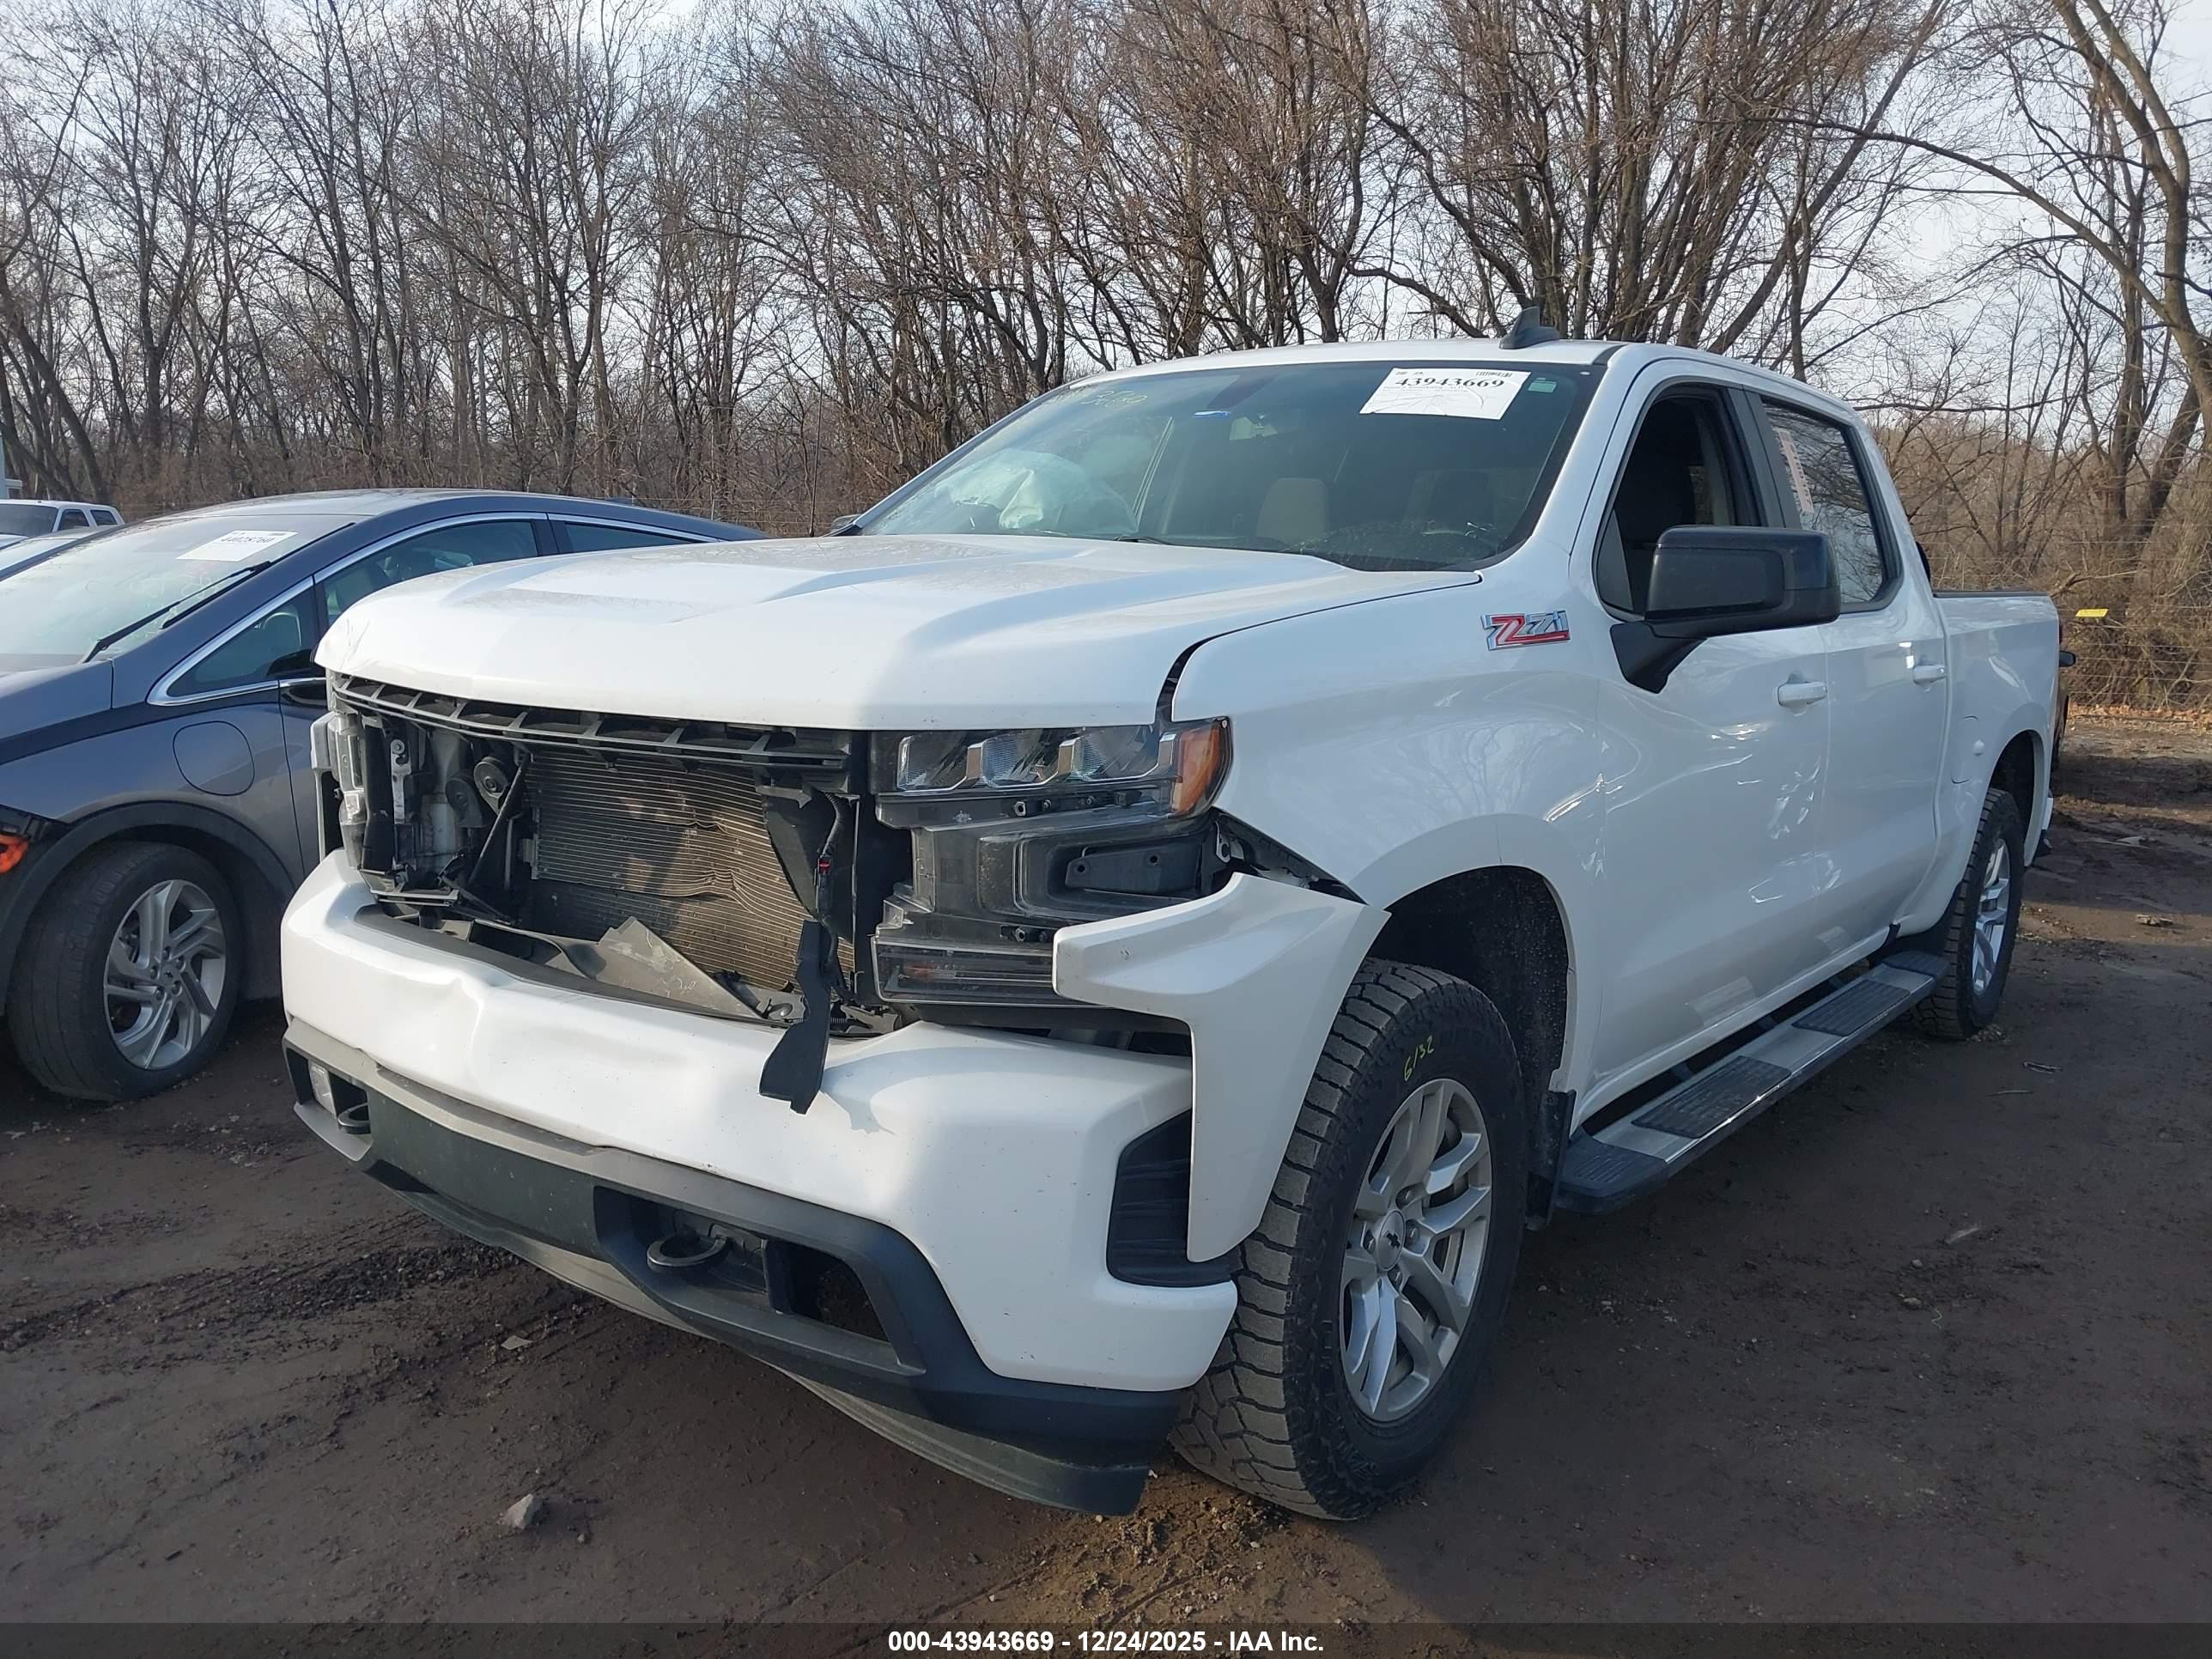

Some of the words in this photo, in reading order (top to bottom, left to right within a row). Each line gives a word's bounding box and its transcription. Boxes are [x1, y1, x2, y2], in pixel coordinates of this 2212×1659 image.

[1395, 377, 1504, 387] 43943669
[1480, 609, 1571, 651] Z71
[1404, 1036, 1435, 1082] 6/32
